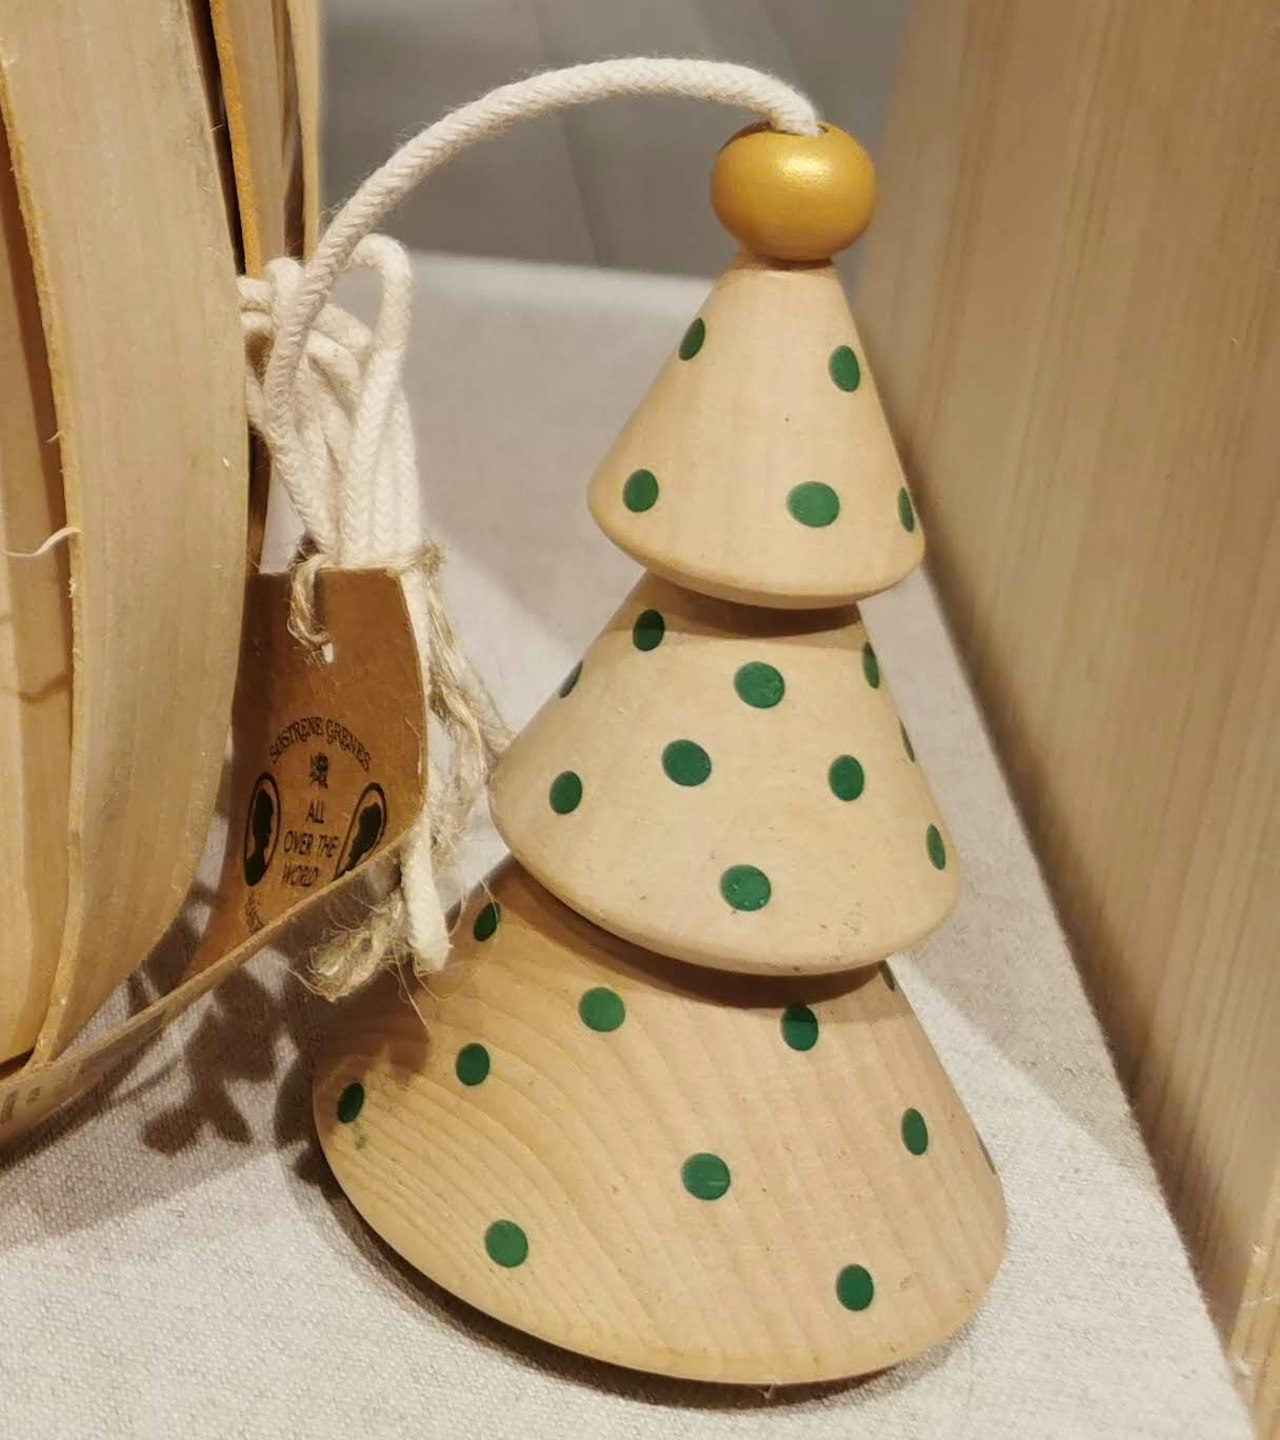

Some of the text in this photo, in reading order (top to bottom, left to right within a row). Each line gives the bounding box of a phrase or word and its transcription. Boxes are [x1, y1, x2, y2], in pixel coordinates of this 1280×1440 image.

[305, 801, 325, 824] ALL
[284, 830, 340, 858] OVER THE
[281, 865, 320, 888] WORLD
